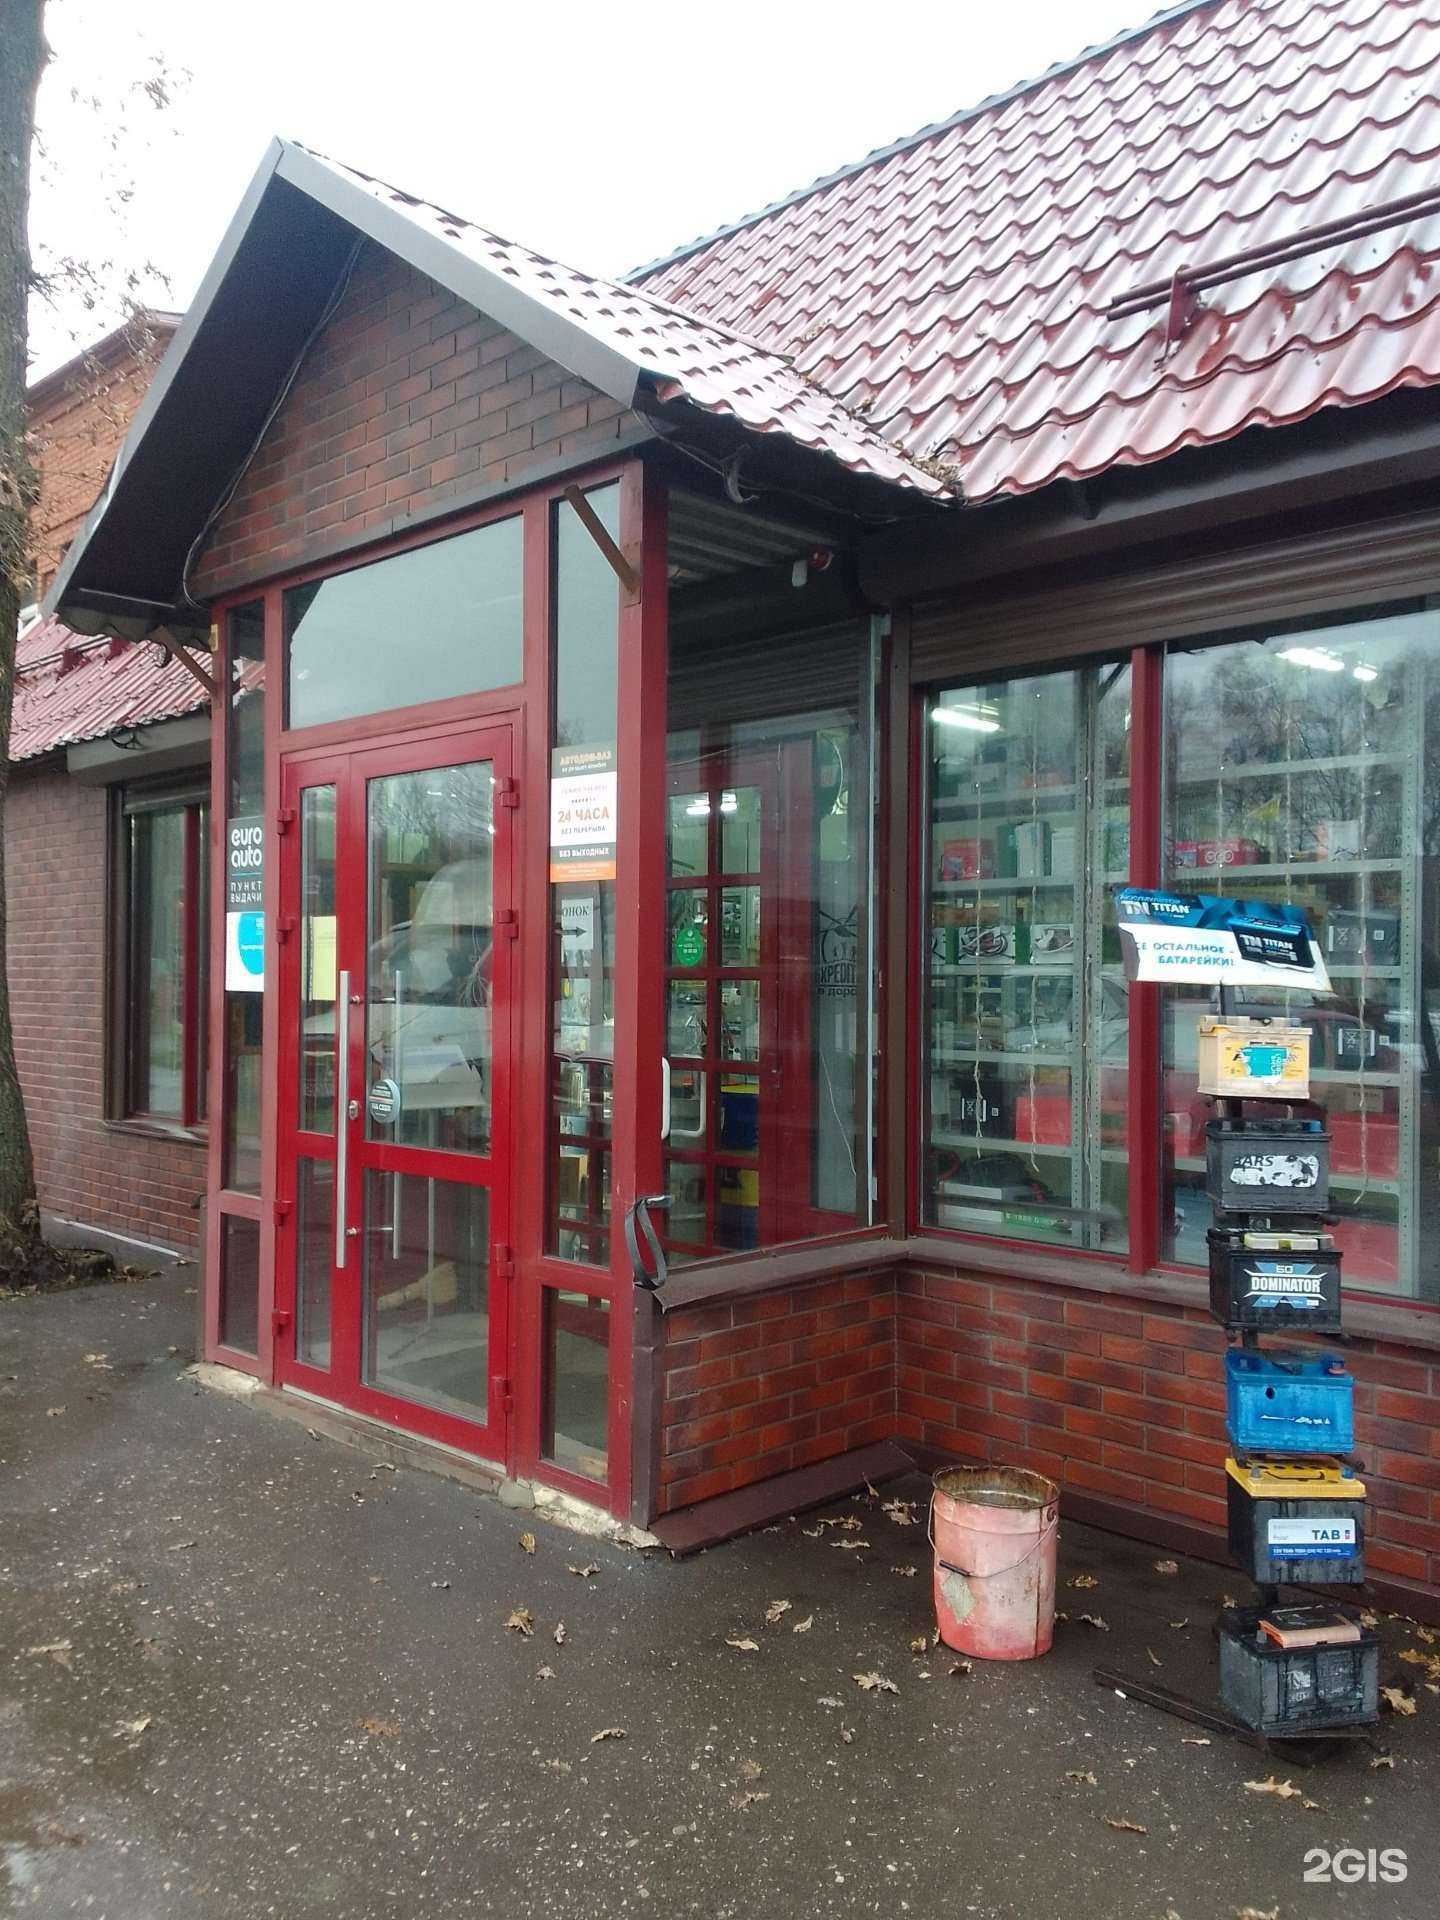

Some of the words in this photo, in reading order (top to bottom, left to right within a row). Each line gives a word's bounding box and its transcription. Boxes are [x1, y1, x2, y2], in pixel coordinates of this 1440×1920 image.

[558, 809, 571, 824] 24
[575, 806, 610, 821] ЧАСА
[231, 827, 263, 847] euro
[231, 845, 263, 868] auto
[559, 849, 571, 858] БЕЗ
[572, 847, 609, 857] ВЫХОДНЫХ
[231, 880, 263, 892] ПУНКТ
[230, 892, 262, 904] ВЫДАЧИ
[1151, 902, 1191, 914] TITAN
[1153, 942, 1225, 954] ОСТАЛЬНОЕ
[1262, 937, 1294, 950] TITAN
[1251, 1276, 1322, 1293] DOMINATOR
[1312, 1529, 1341, 1541] TAB
